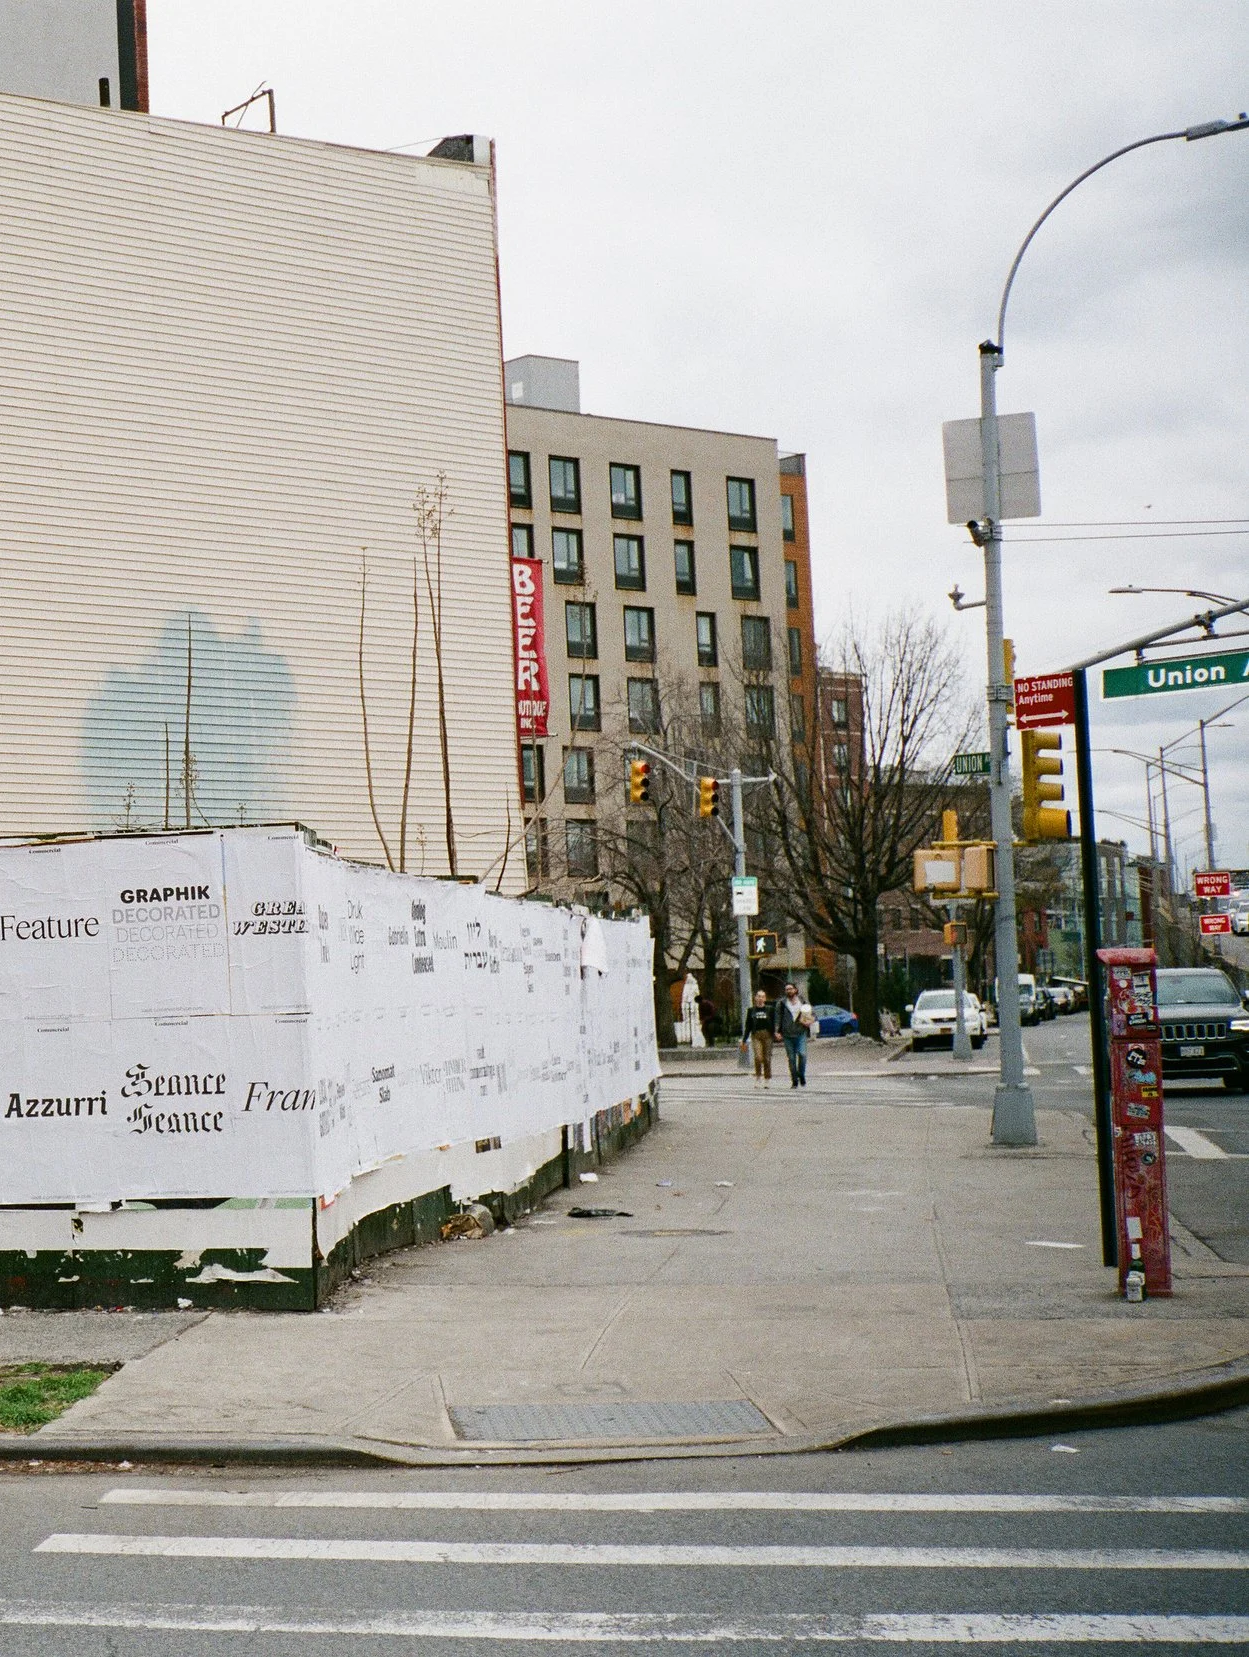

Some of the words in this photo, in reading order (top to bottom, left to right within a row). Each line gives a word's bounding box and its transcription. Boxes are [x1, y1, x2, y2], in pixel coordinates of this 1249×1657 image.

[512, 563, 541, 692] BEER
[1017, 683, 1030, 693] NO
[1031, 677, 1073, 692] STANDING
[1148, 665, 1226, 688] Union
[1019, 693, 1054, 706] Anytime
[956, 755, 983, 773] UNION
[1196, 875, 1228, 885] WRONG
[120, 885, 210, 904] GRAPHIK
[1203, 886, 1223, 894] WAY
[112, 903, 221, 924] DECORATED
[251, 900, 306, 917] GREA
[0, 914, 100, 941] Feature
[116, 923, 219, 943] DECORATED
[233, 919, 309, 936] WESTE
[112, 942, 225, 963] DECORATED
[5, 1090, 107, 1118] Azzurri
[241, 1081, 316, 1112] Fran
